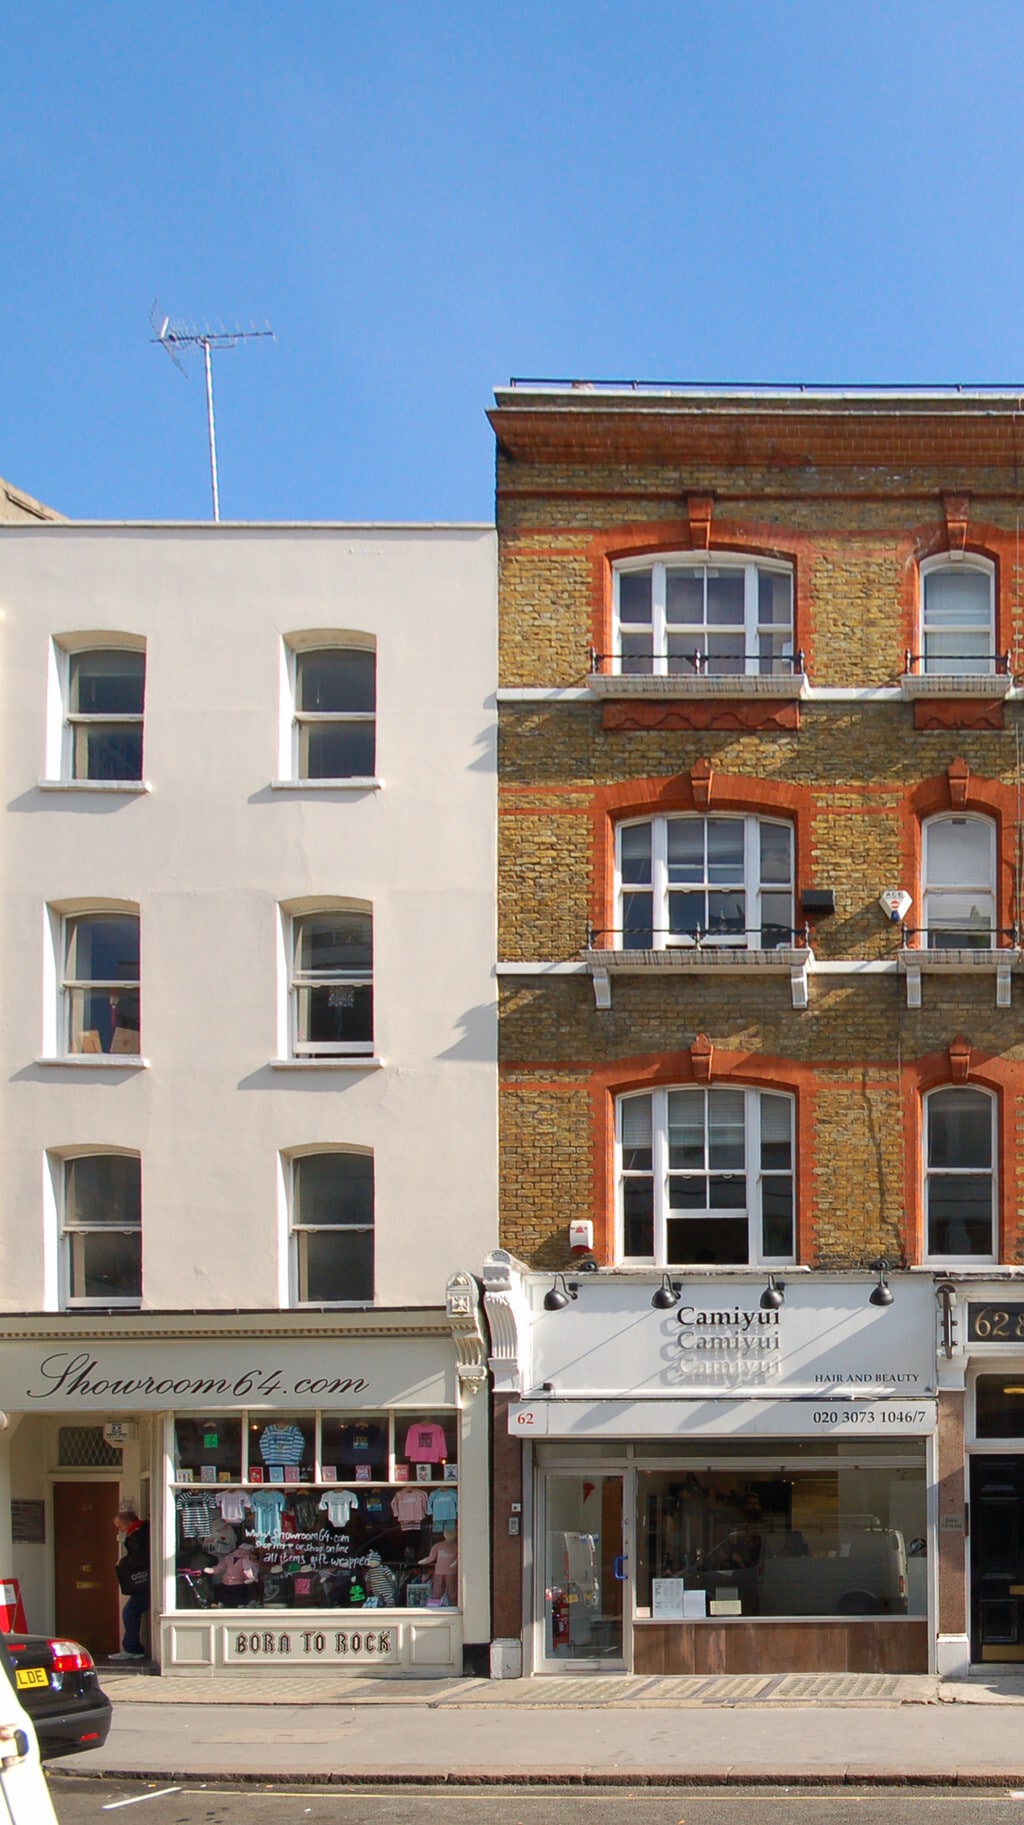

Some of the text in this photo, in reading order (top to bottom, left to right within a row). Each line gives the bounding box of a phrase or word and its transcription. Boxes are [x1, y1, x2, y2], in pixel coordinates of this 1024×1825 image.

[677, 1306, 780, 1331] Camiyui
[677, 1331, 780, 1355] Camiyui
[27, 1353, 369, 1398] Showroom64.com
[815, 1374, 919, 1382] HAIR AND BEAUTY
[517, 1412, 534, 1424] 62
[813, 1410, 926, 1423] 020 3073 1046/7
[263, 1553, 278, 1563] all
[279, 1553, 306, 1565] items
[310, 1553, 328, 1569] gift
[235, 1631, 392, 1655] BORN TO ROCK
[17, 1670, 45, 1685] LDE
